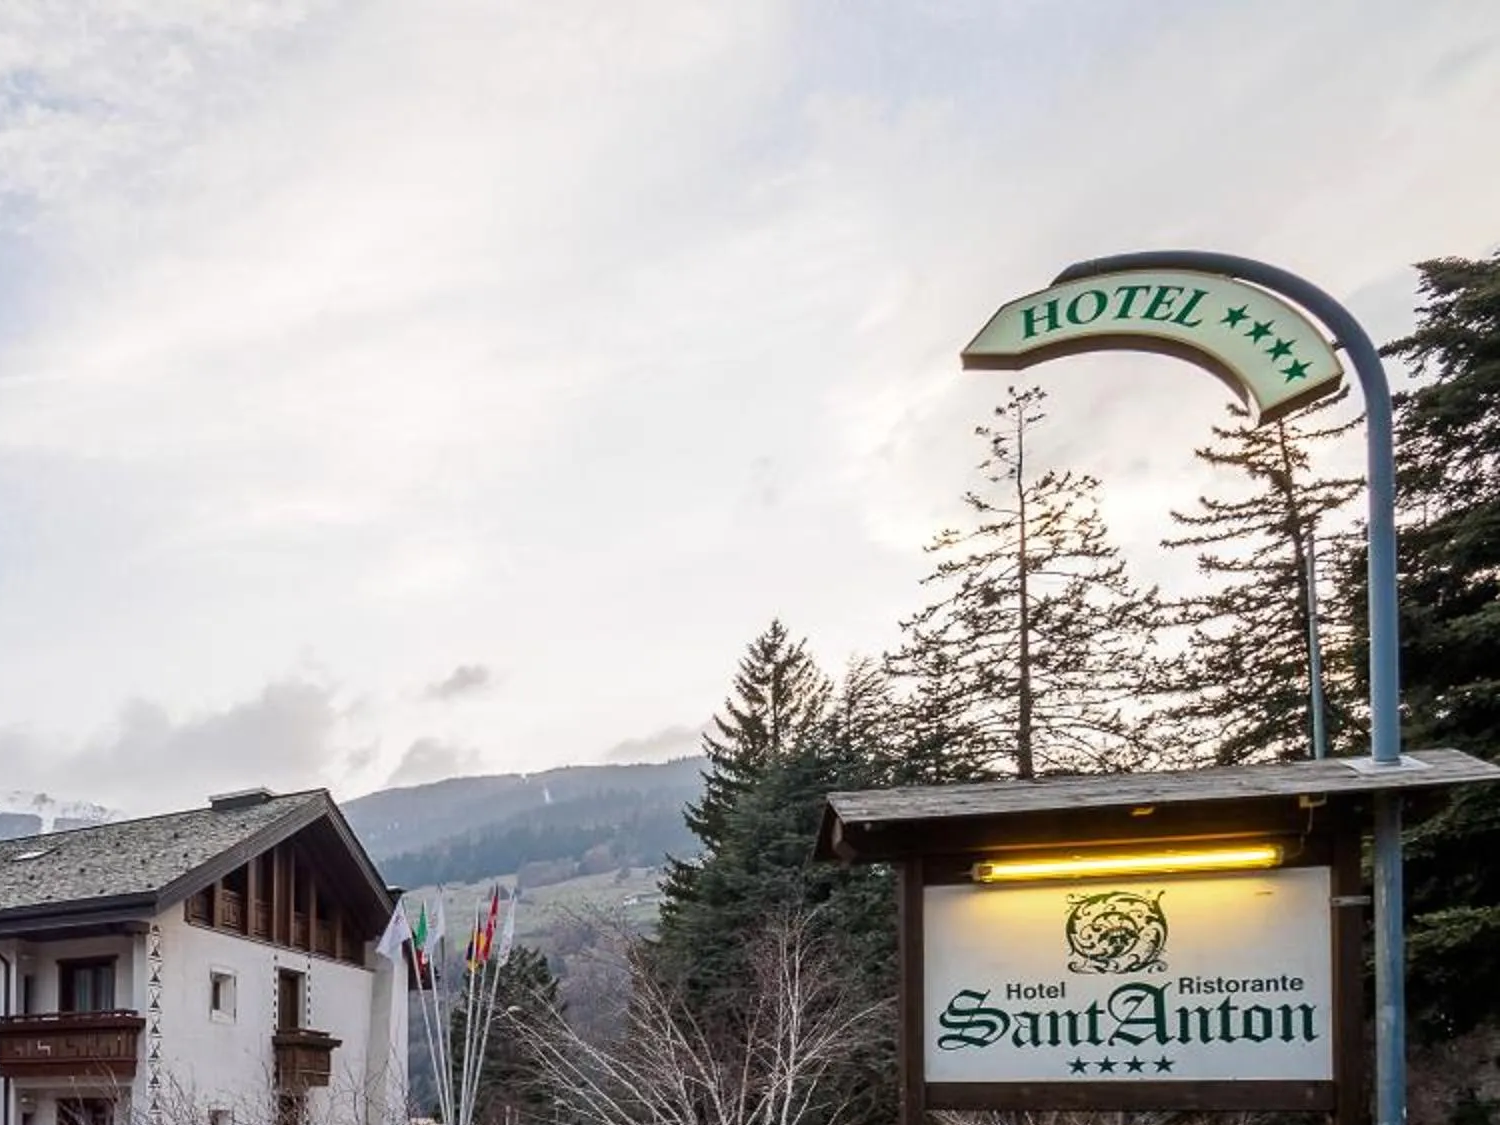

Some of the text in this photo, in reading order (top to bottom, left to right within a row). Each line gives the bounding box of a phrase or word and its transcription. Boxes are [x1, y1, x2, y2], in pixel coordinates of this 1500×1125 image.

[1022, 285, 1211, 340] HOTEL
[1006, 975, 1304, 1000] Hotel Ristorante
